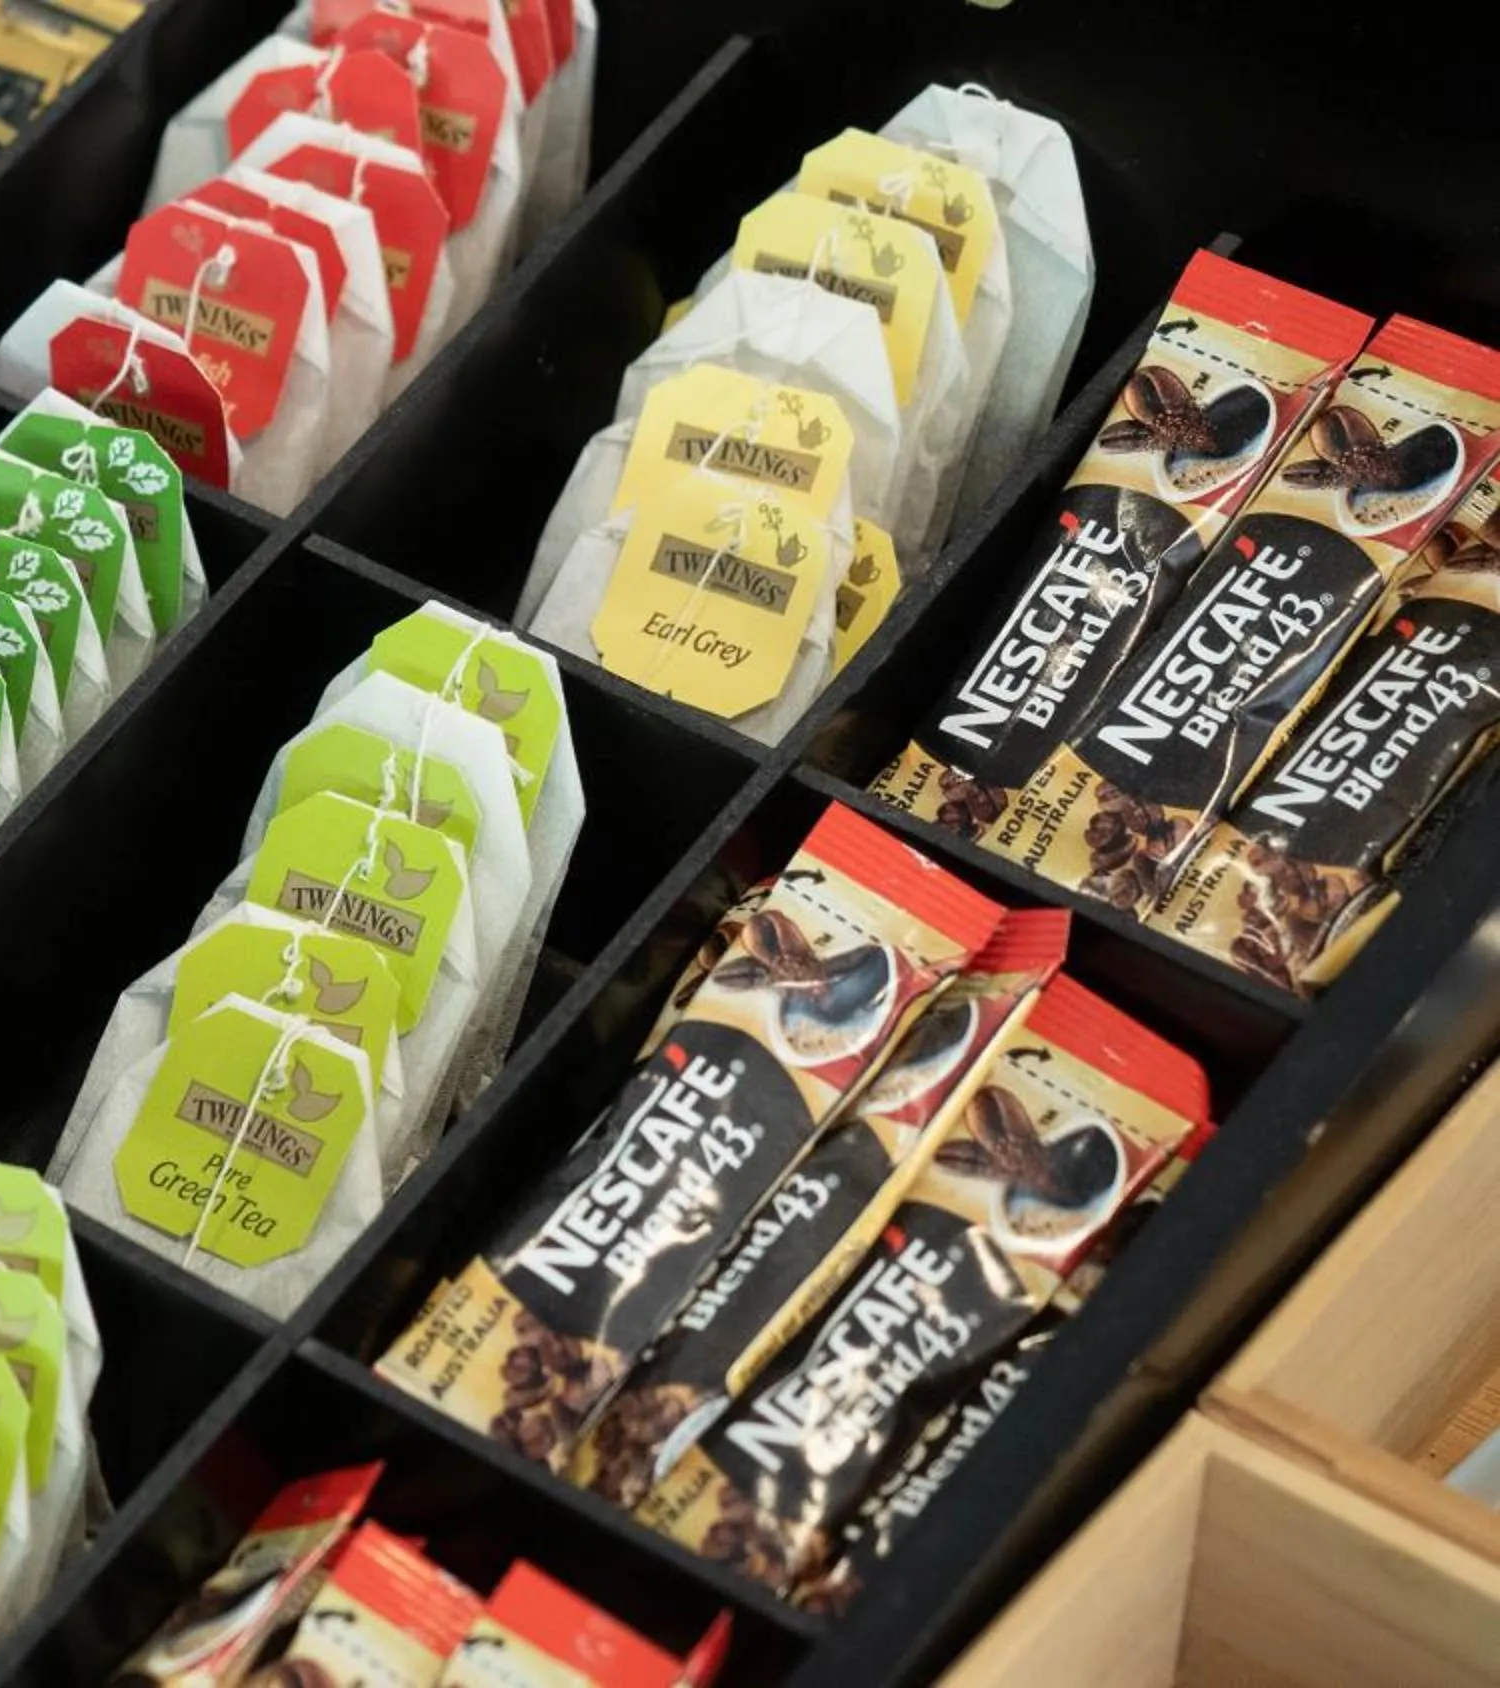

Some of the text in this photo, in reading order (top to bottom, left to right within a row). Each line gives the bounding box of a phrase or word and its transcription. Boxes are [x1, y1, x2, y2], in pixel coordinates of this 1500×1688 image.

[152, 292, 264, 350] TWNINGS
[643, 611, 752, 668] Earl Grey
[996, 763, 1060, 848] ROASTED
[1024, 770, 1094, 872] AUSTRALIA
[1032, 799, 1053, 823] IN
[291, 886, 409, 947] TWNINGS
[148, 1160, 278, 1239] Green Tea
[202, 1152, 252, 1190] Pure
